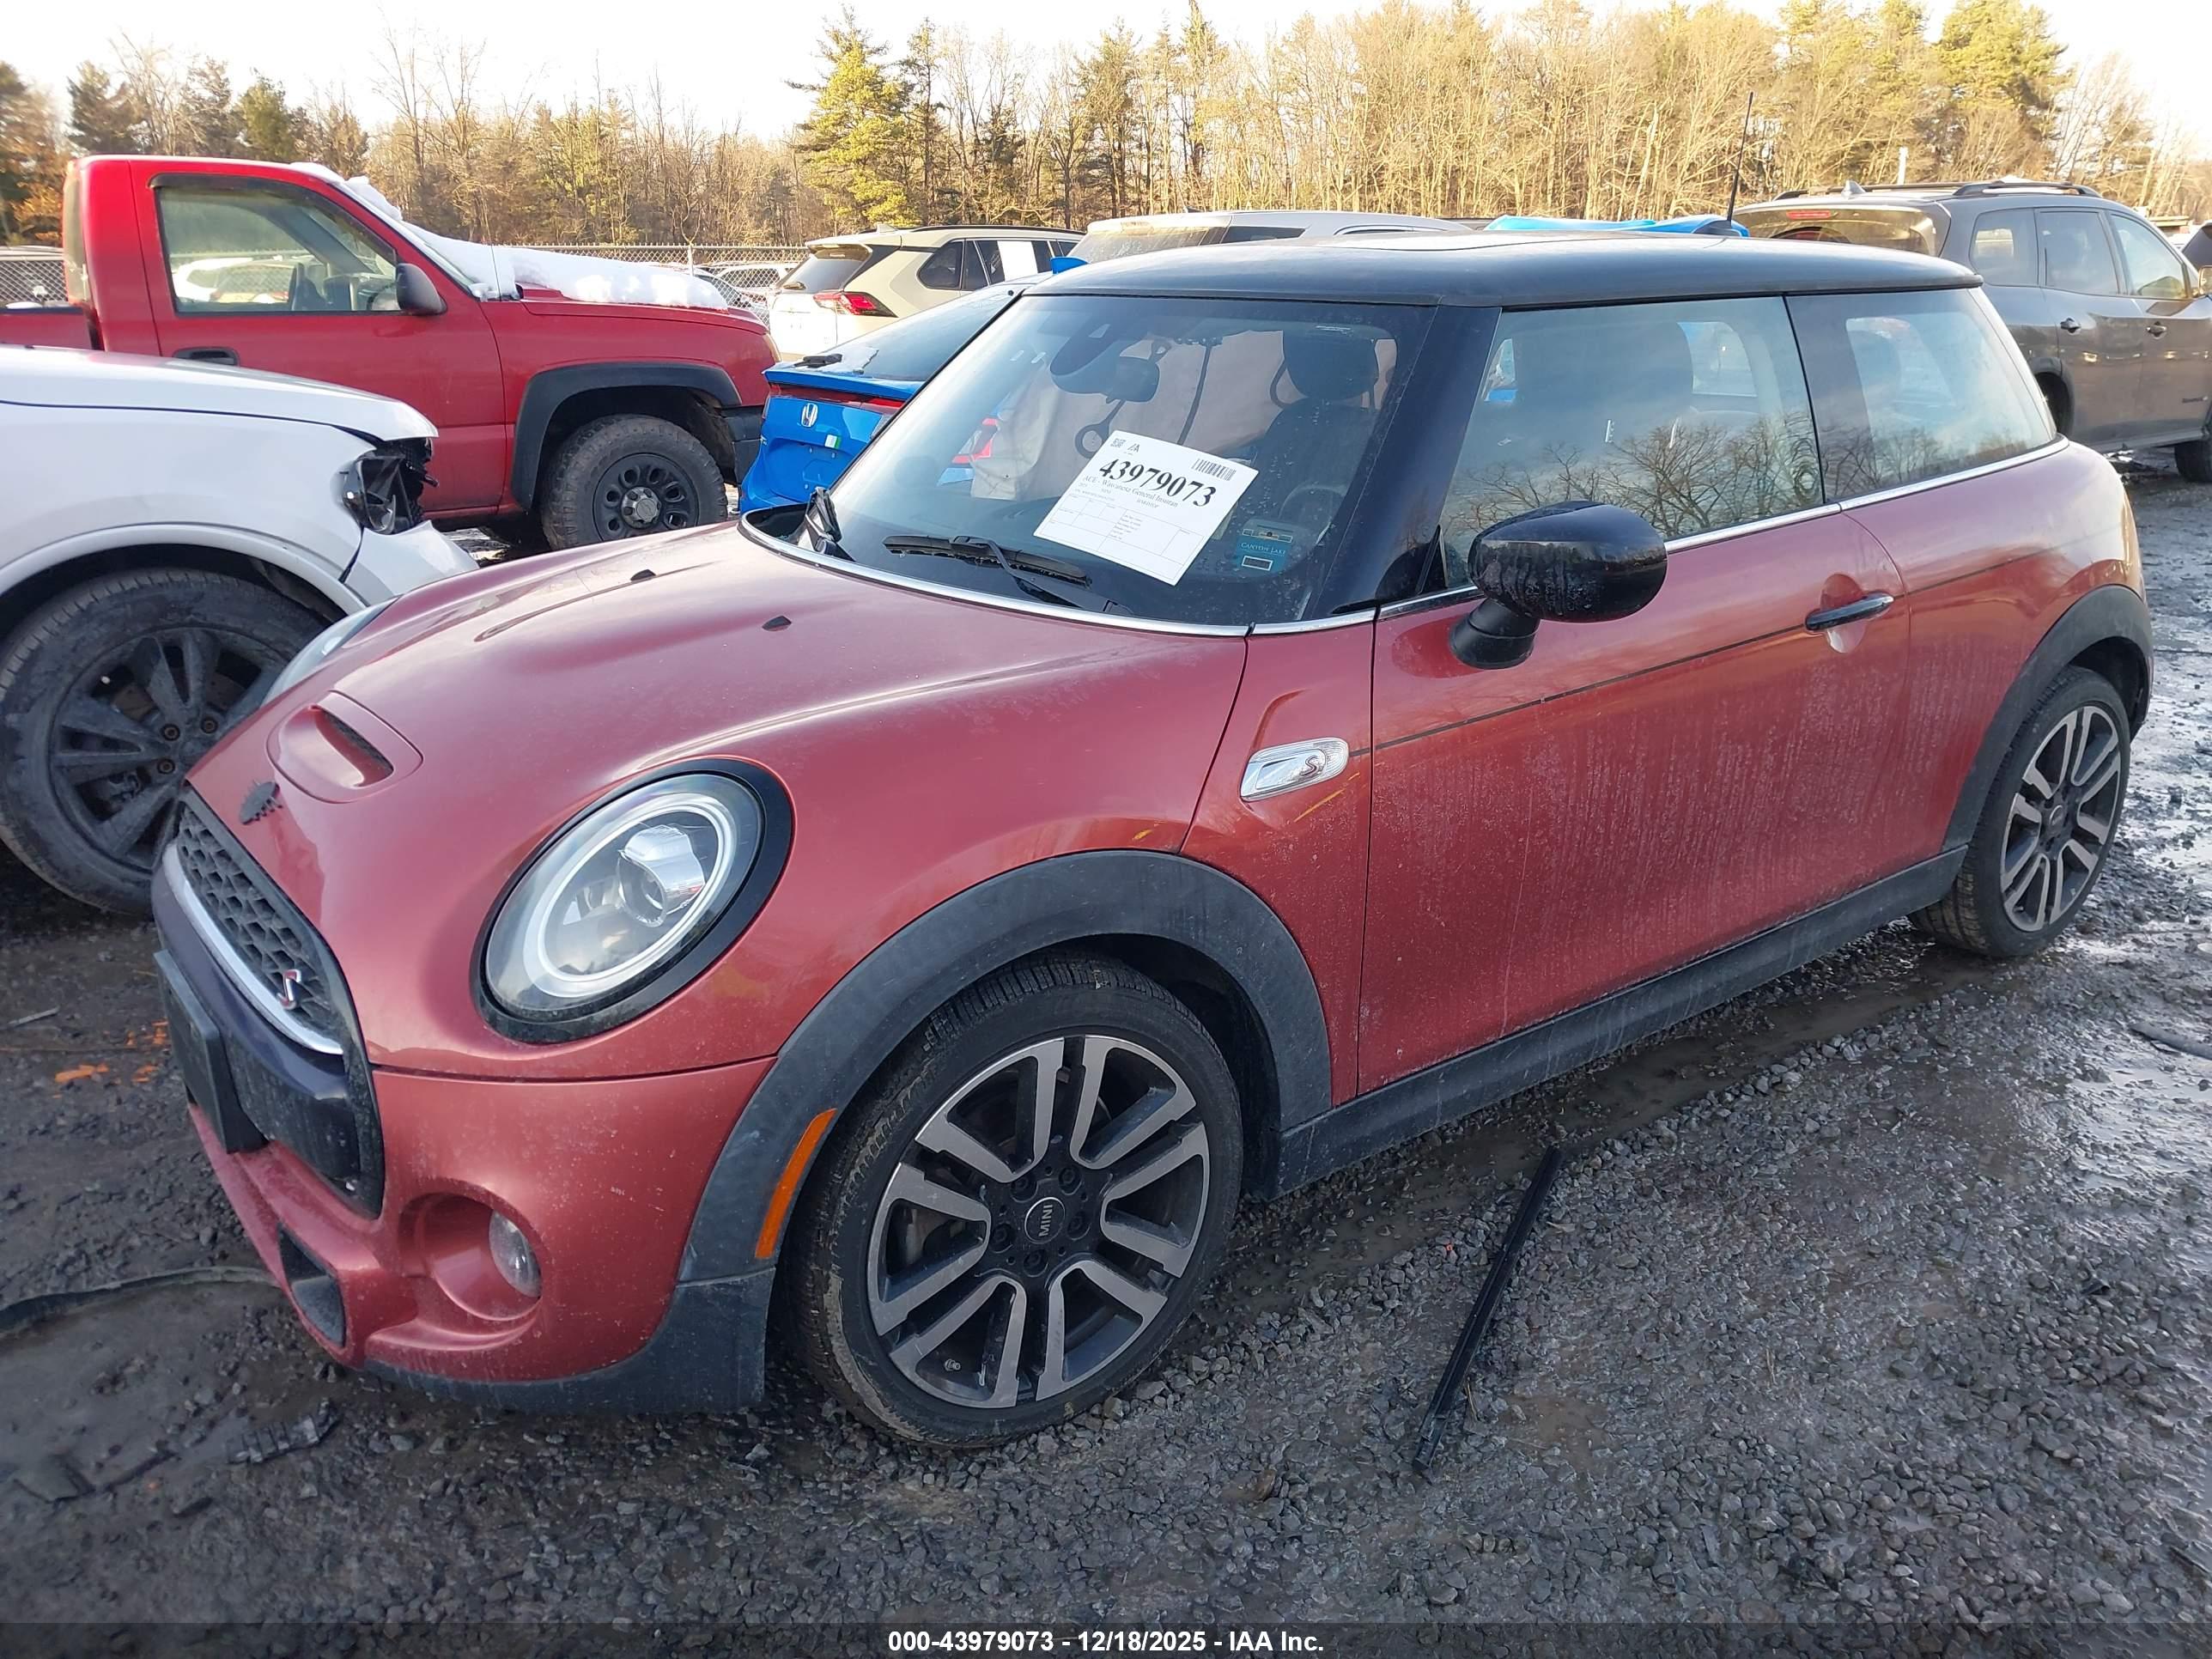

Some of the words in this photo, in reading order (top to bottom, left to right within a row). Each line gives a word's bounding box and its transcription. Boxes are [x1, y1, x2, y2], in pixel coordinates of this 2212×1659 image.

[1099, 459, 1217, 507] 43979073
[1132, 488, 1157, 500] General
[1241, 542, 1268, 551] CANYON
[1038, 1204, 1053, 1237] MINI
